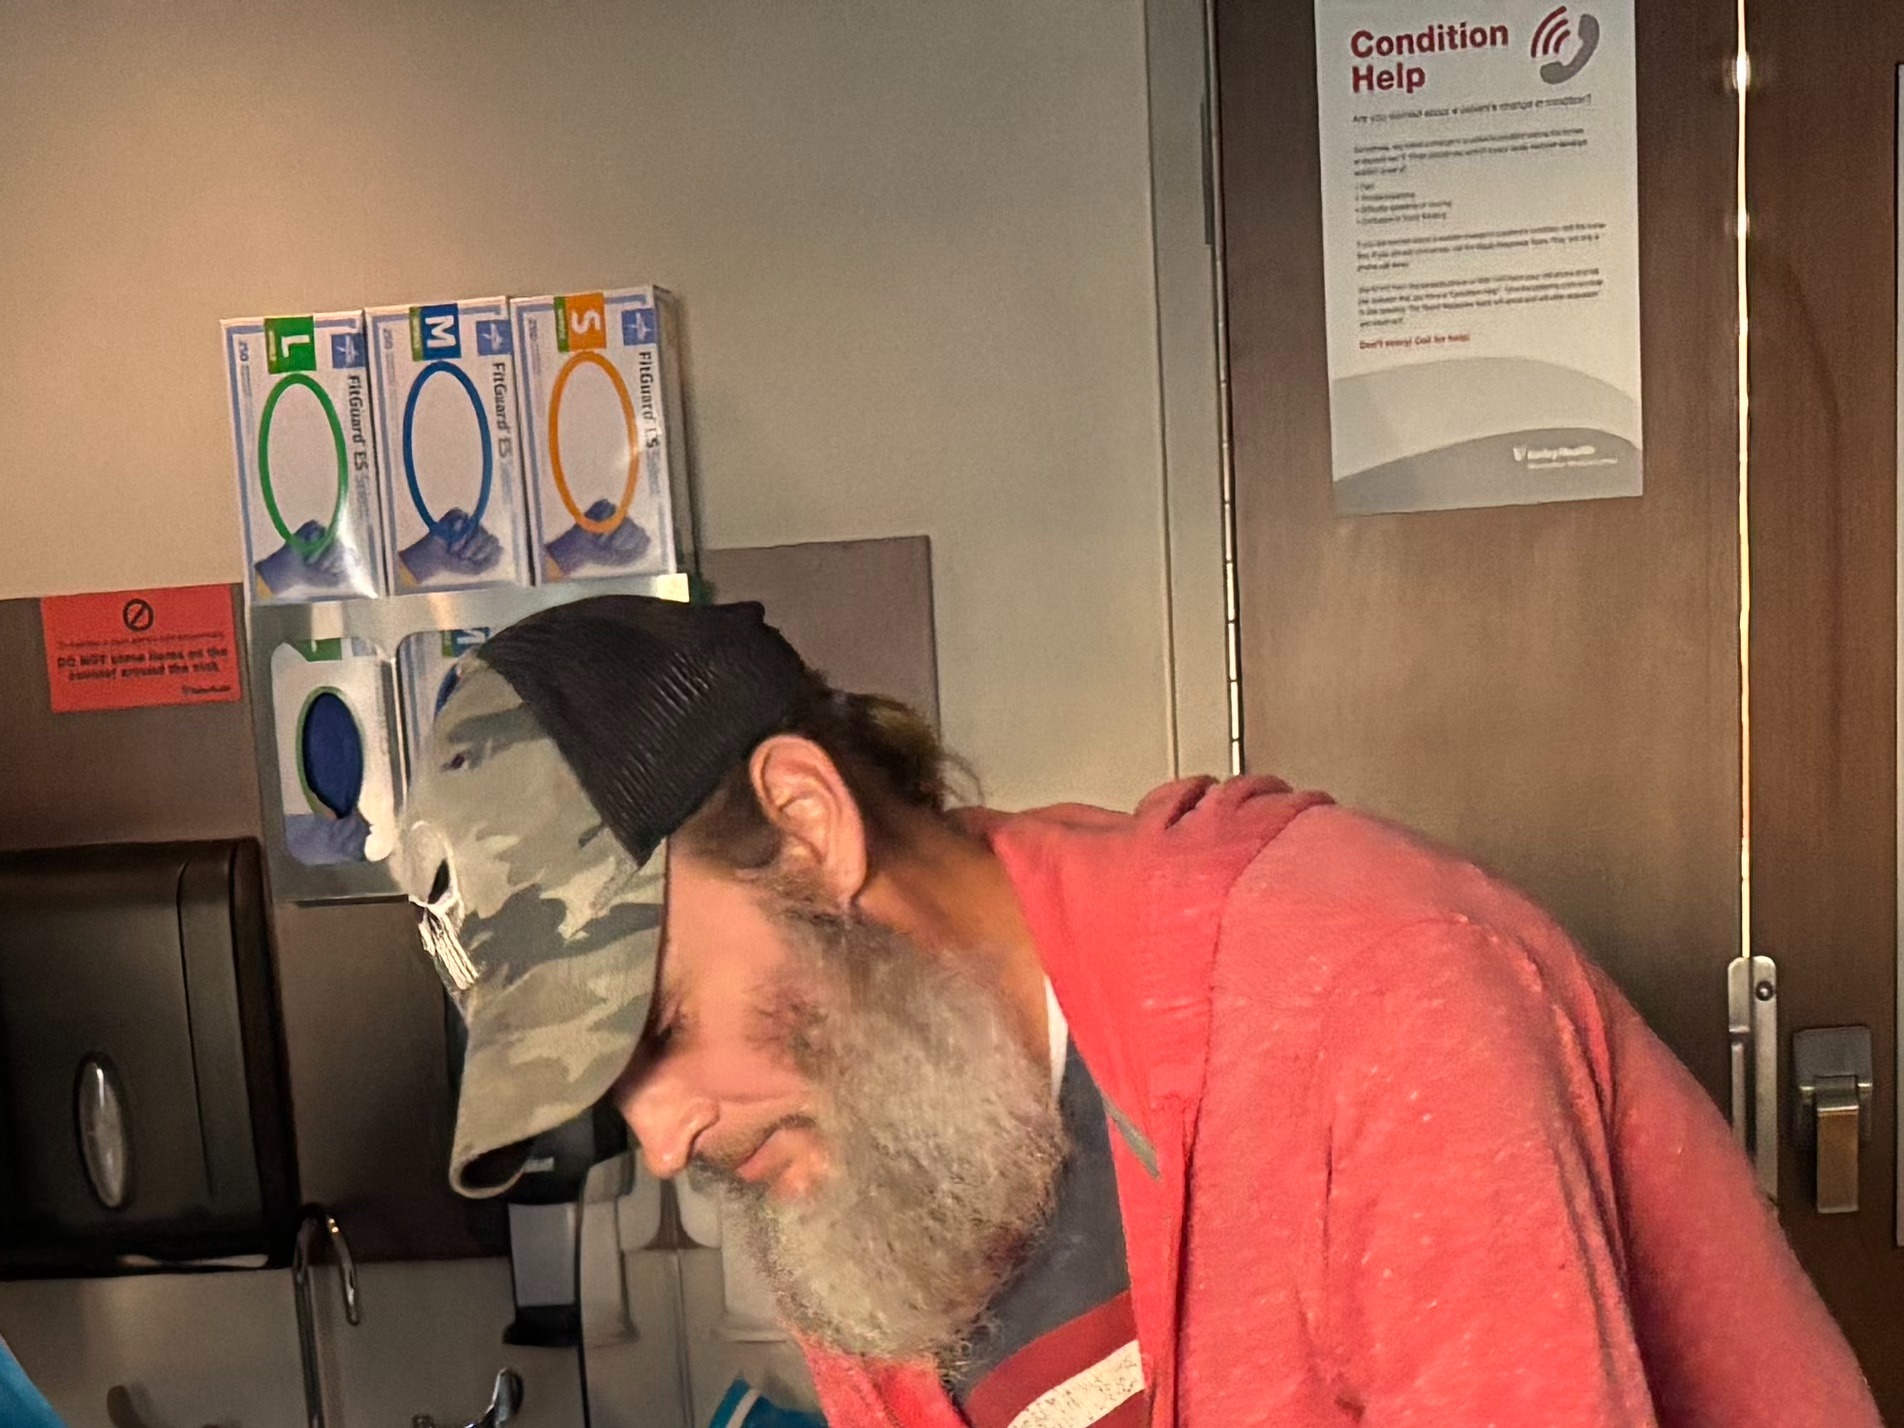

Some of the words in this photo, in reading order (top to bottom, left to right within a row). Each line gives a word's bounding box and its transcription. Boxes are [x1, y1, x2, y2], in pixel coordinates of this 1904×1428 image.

[1350, 22, 1509, 58] Condition
[1351, 62, 1426, 94] Help
[424, 314, 457, 348] M
[571, 309, 602, 335] S
[280, 333, 311, 358] L
[492, 362, 512, 434] FitGuard
[639, 351, 657, 421] FitGuard
[348, 375, 367, 444] FitGuard
[353, 450, 369, 471] ES
